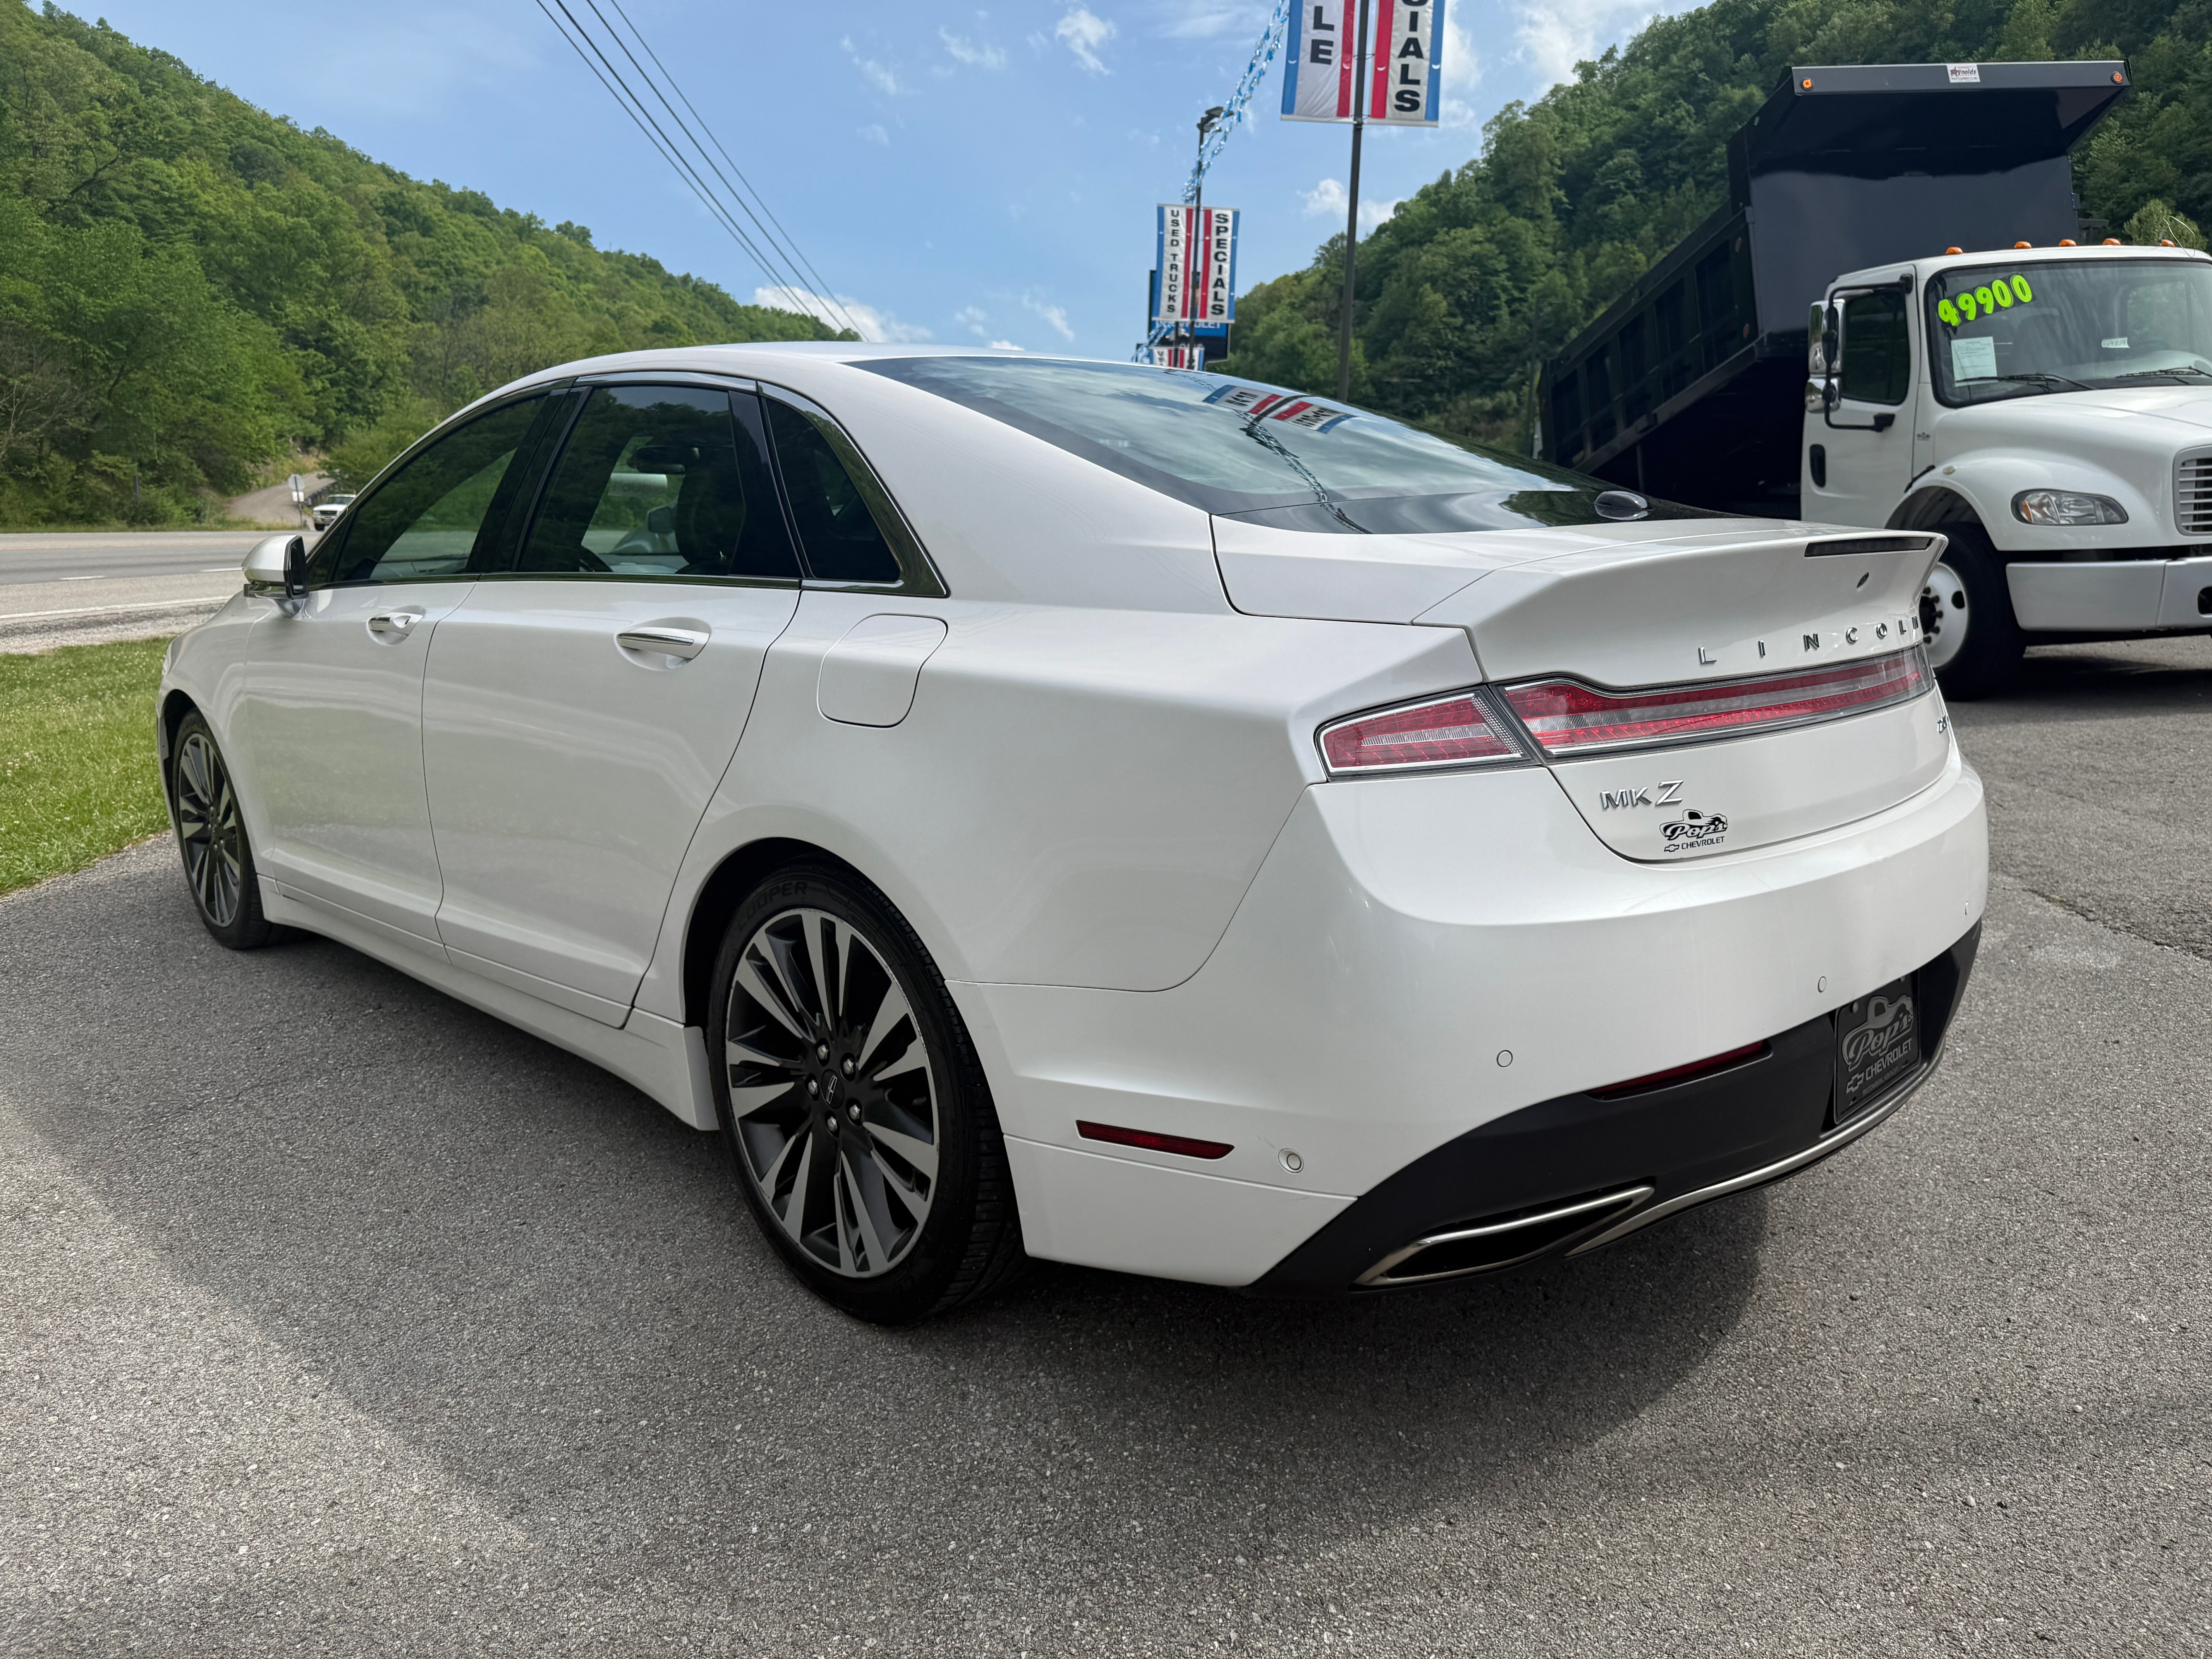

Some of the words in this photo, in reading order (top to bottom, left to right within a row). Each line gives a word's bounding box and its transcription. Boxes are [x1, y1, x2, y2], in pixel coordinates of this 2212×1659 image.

[1171, 210, 1180, 247] USED
[1167, 254, 1178, 313] TRUCKS
[1211, 213, 1228, 315] SPECIALS
[1938, 275, 2033, 327] 49900
[1698, 616, 1918, 665] LINCOLN
[1681, 836, 1725, 850] CHEVROLET
[1865, 1037, 1912, 1081] CHEVROLET
